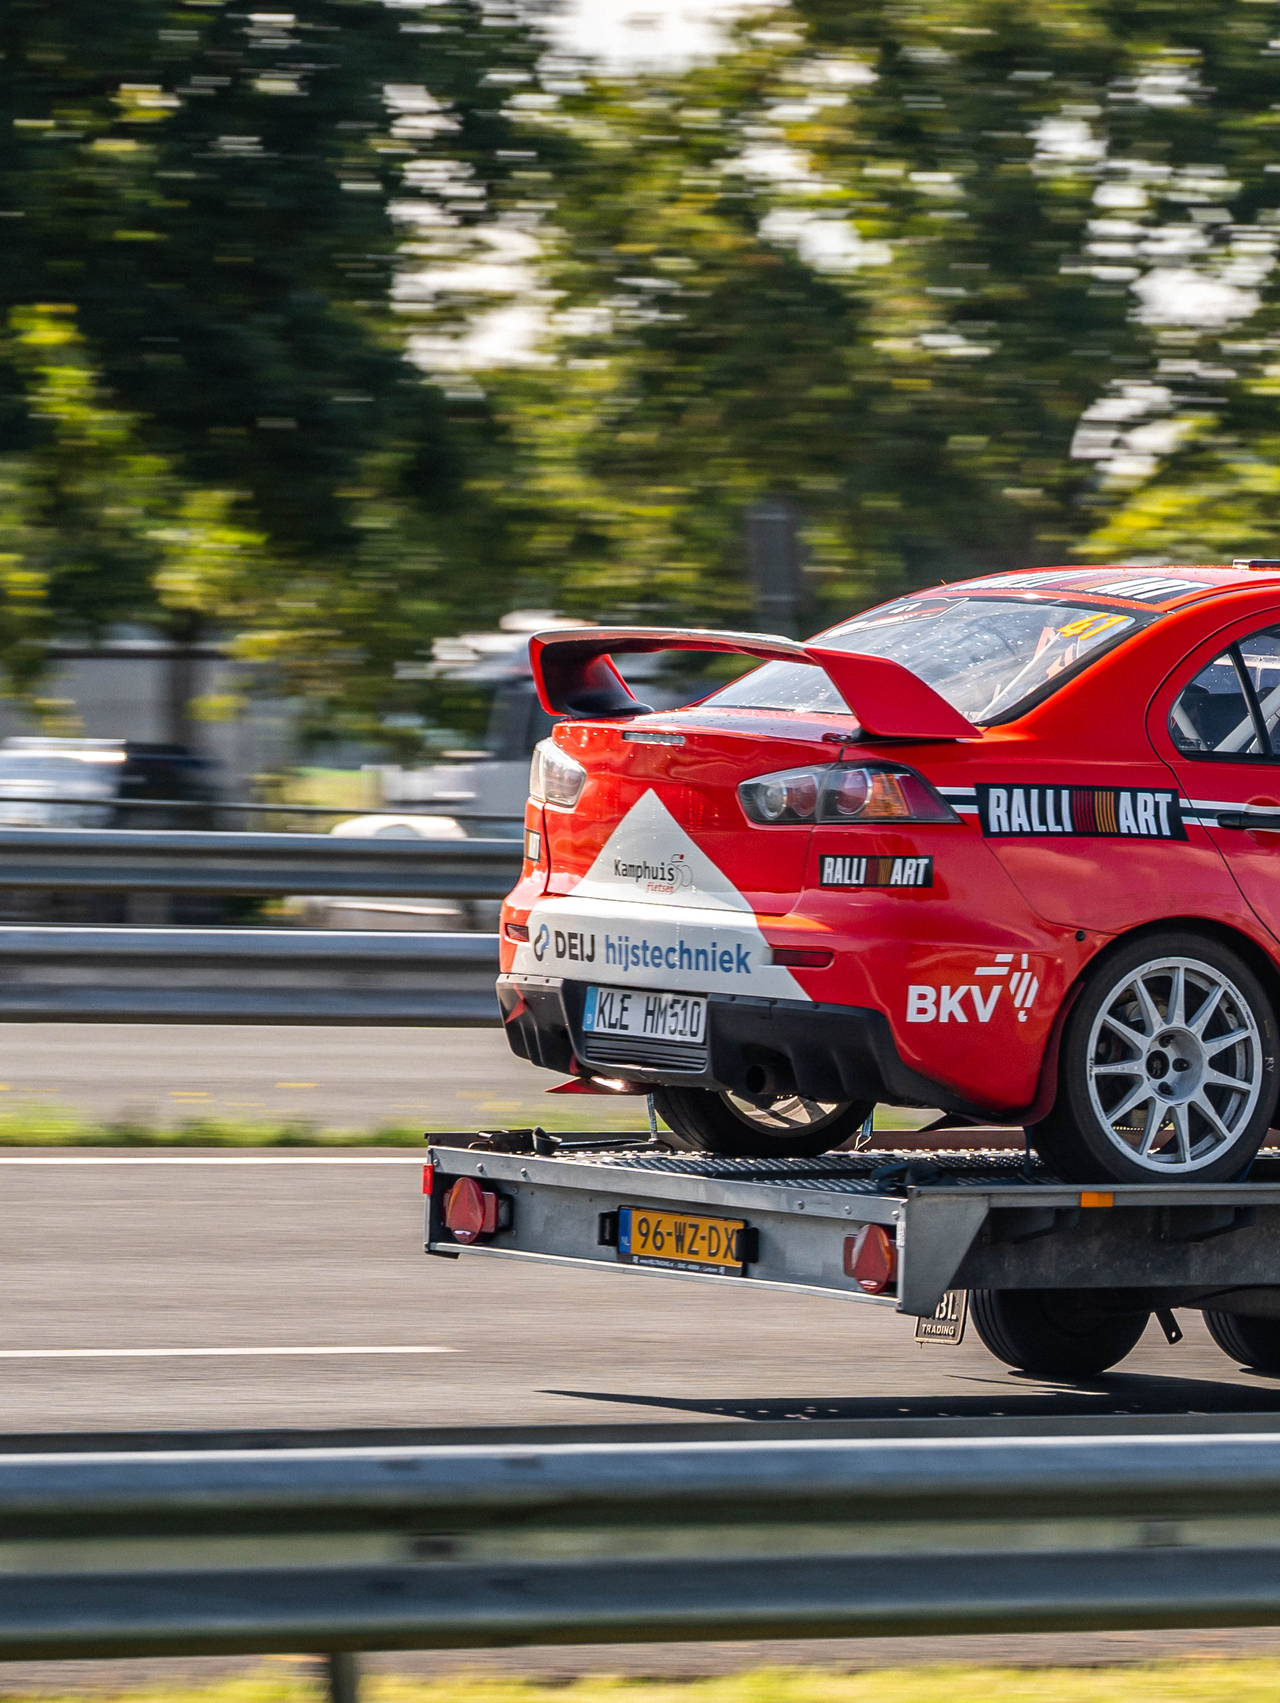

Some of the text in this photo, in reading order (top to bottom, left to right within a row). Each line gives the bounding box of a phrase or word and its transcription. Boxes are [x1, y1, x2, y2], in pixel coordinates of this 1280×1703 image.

[1056, 612, 1129, 640] 41
[987, 787, 1173, 836] RALLI ART
[613, 859, 675, 883] Kamphuis
[822, 857, 930, 885] RALLI ART
[554, 930, 753, 974] DEIJ hijstechniek
[596, 991, 701, 1037] KLE HM510
[905, 985, 1003, 1023] BKV
[636, 1215, 737, 1260] 96-WZ-DX
[921, 1323, 955, 1336] TRADING
